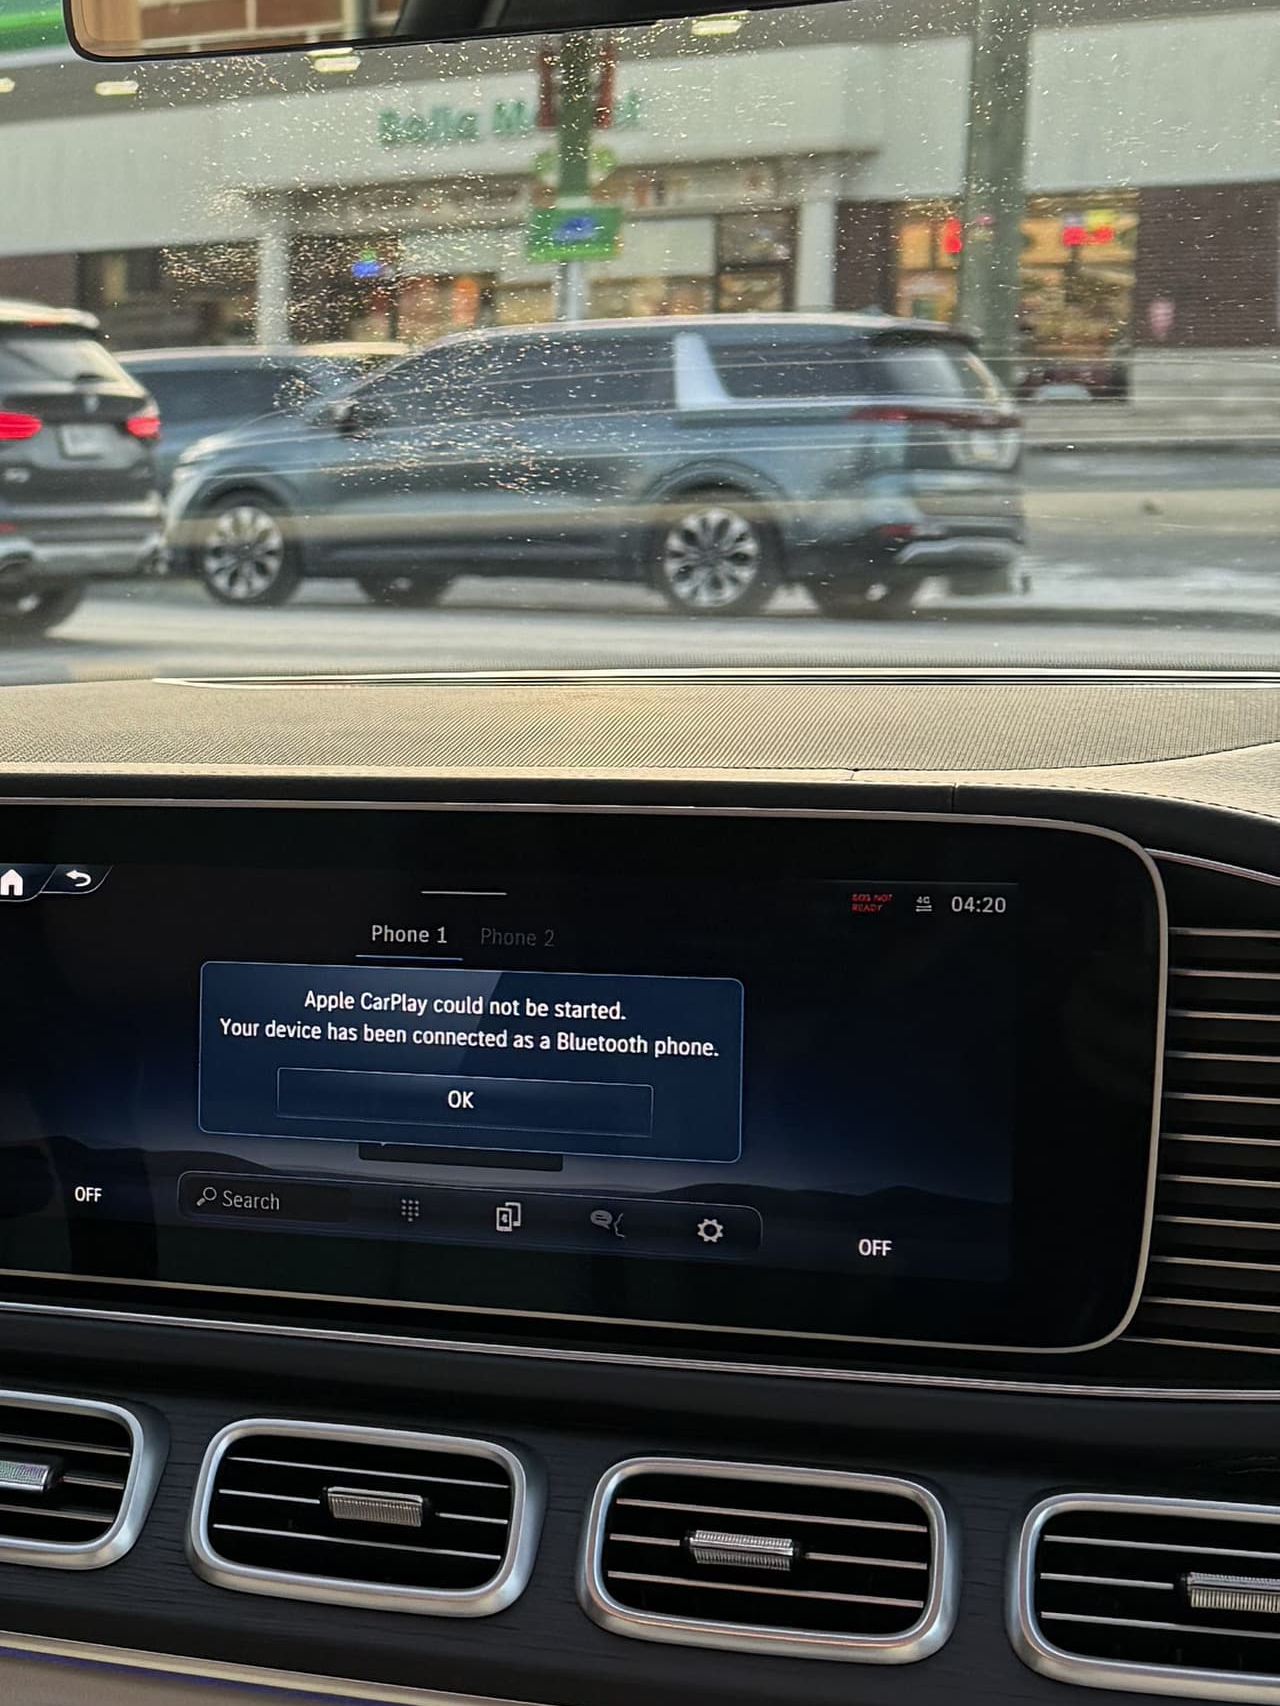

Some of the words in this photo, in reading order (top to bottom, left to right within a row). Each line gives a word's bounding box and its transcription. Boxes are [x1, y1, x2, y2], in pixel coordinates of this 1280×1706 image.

[951, 895, 1007, 913] 04:20
[371, 924, 430, 943] Phone
[436, 926, 447, 943] 1
[481, 927, 537, 946] Phone
[544, 929, 555, 947] 2
[304, 990, 355, 1012] Apple
[360, 992, 428, 1017] CarPlay
[433, 996, 484, 1015] could
[490, 999, 520, 1017] not
[525, 998, 549, 1017] be
[554, 1001, 627, 1020] started.
[220, 1018, 260, 1037] Your
[265, 1019, 321, 1040] device
[327, 1022, 358, 1041] has
[363, 1024, 407, 1043] been
[412, 1029, 508, 1048] connected
[512, 1033, 535, 1049] as
[539, 1035, 551, 1050] a
[556, 1032, 648, 1054] Bluetooth
[654, 1036, 720, 1058] phone.
[447, 1090, 474, 1109] OK
[74, 1186, 102, 1203] OFF
[222, 1190, 280, 1211] Search
[858, 1238, 893, 1256] OFF
